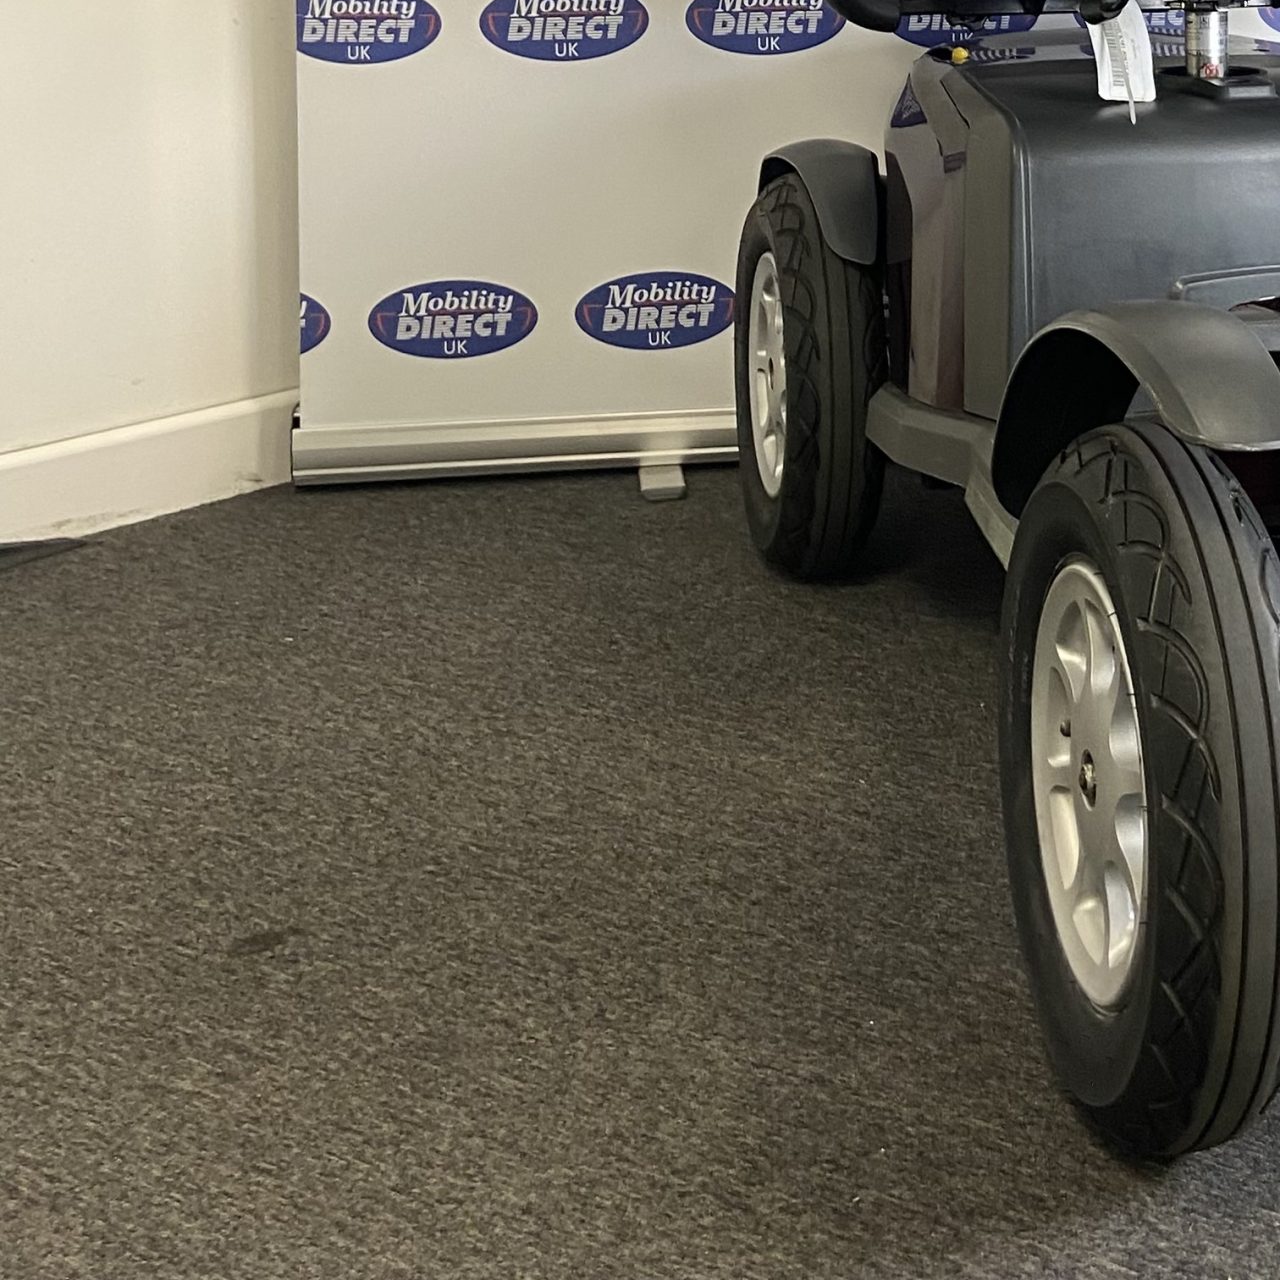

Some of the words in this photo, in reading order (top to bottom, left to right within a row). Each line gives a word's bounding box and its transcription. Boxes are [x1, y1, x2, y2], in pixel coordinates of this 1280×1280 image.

[301, 19, 415, 43] DIRECT
[507, 15, 623, 42] DIRECT
[712, 10, 823, 36] DIRECT
[348, 45, 372, 60] UK
[554, 42, 579, 57] UK
[757, 36, 781, 51] UK
[398, 291, 514, 318] Mobility
[605, 282, 715, 310] Mobility
[395, 312, 512, 341] DIRECT
[602, 303, 713, 332] DIRECT
[443, 339, 468, 355] UK
[647, 330, 671, 346] UK
